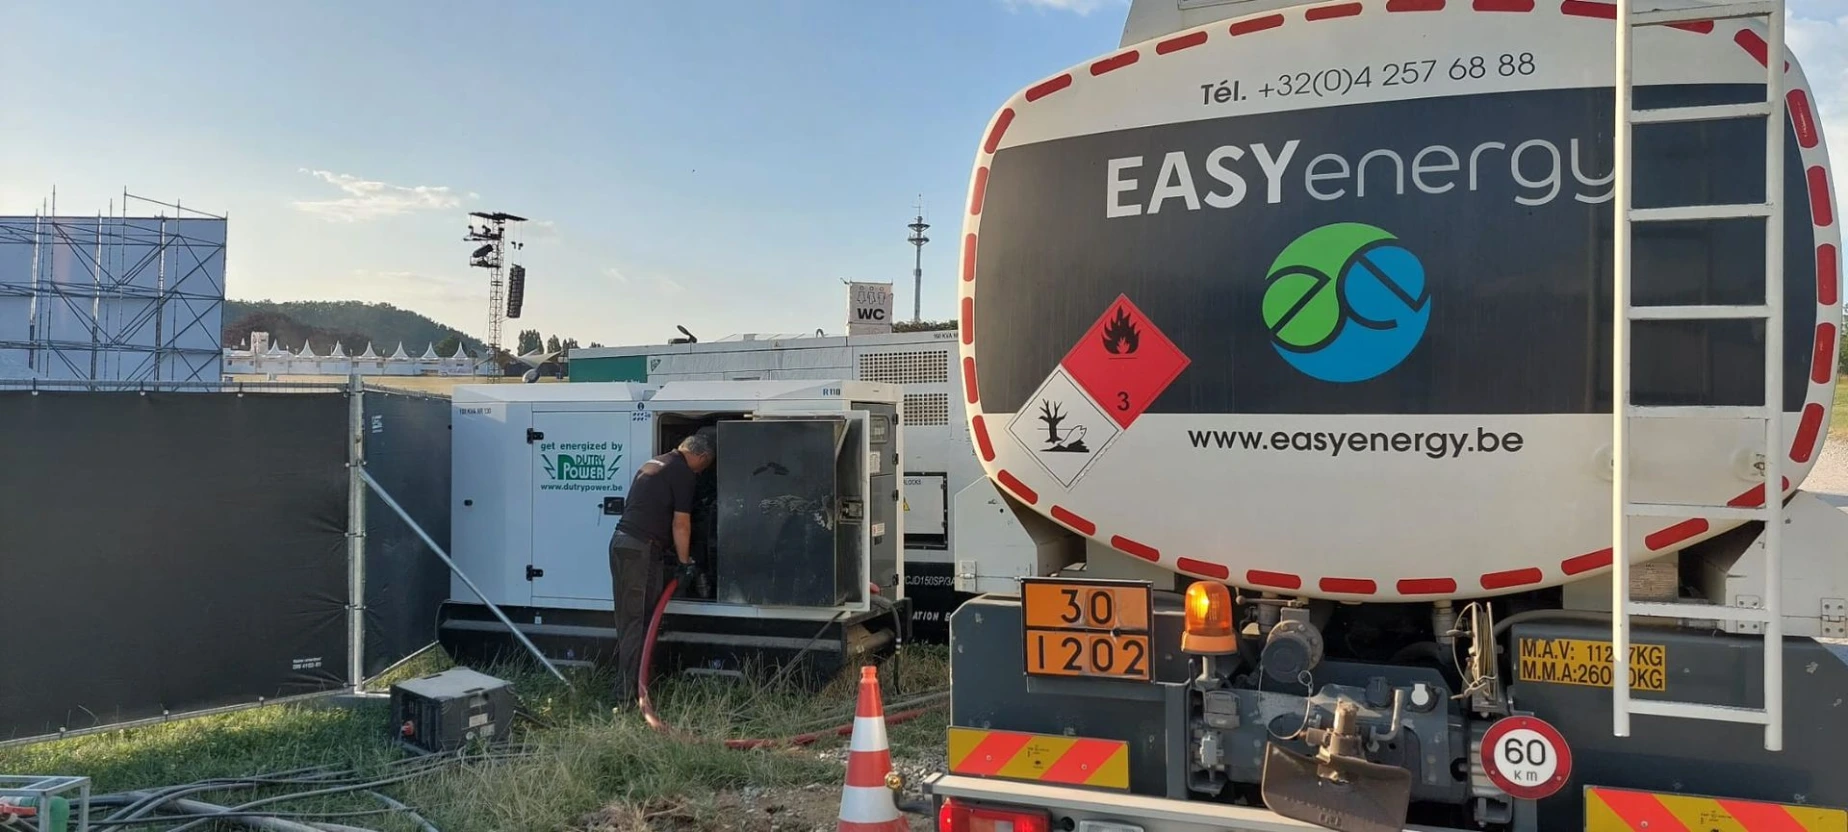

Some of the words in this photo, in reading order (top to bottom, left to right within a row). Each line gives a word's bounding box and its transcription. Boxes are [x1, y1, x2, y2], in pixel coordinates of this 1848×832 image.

[1200, 80, 1246, 105] Tél.
[1258, 66, 1372, 98] +32(0)4
[1382, 59, 1437, 86] 257
[1448, 56, 1486, 80] 68
[1497, 52, 1536, 76] 88
[857, 308, 885, 320] WC
[1117, 391, 1130, 411] 3
[540, 442, 556, 451] get
[560, 441, 607, 452] energized
[611, 441, 623, 452] by
[1187, 427, 1524, 459] www.easyenergy.be
[563, 462, 605, 480] POWER
[576, 454, 605, 465] DUTRY
[540, 482, 623, 492] www.dutrypower.be
[1061, 589, 1112, 625] 30
[1038, 635, 1145, 676] 1202
[1522, 640, 1574, 660] M.A.V:
[1587, 645, 1662, 667] 1127KG
[1522, 660, 1663, 689] M.M.A:2600KG
[1505, 738, 1546, 766] 60
